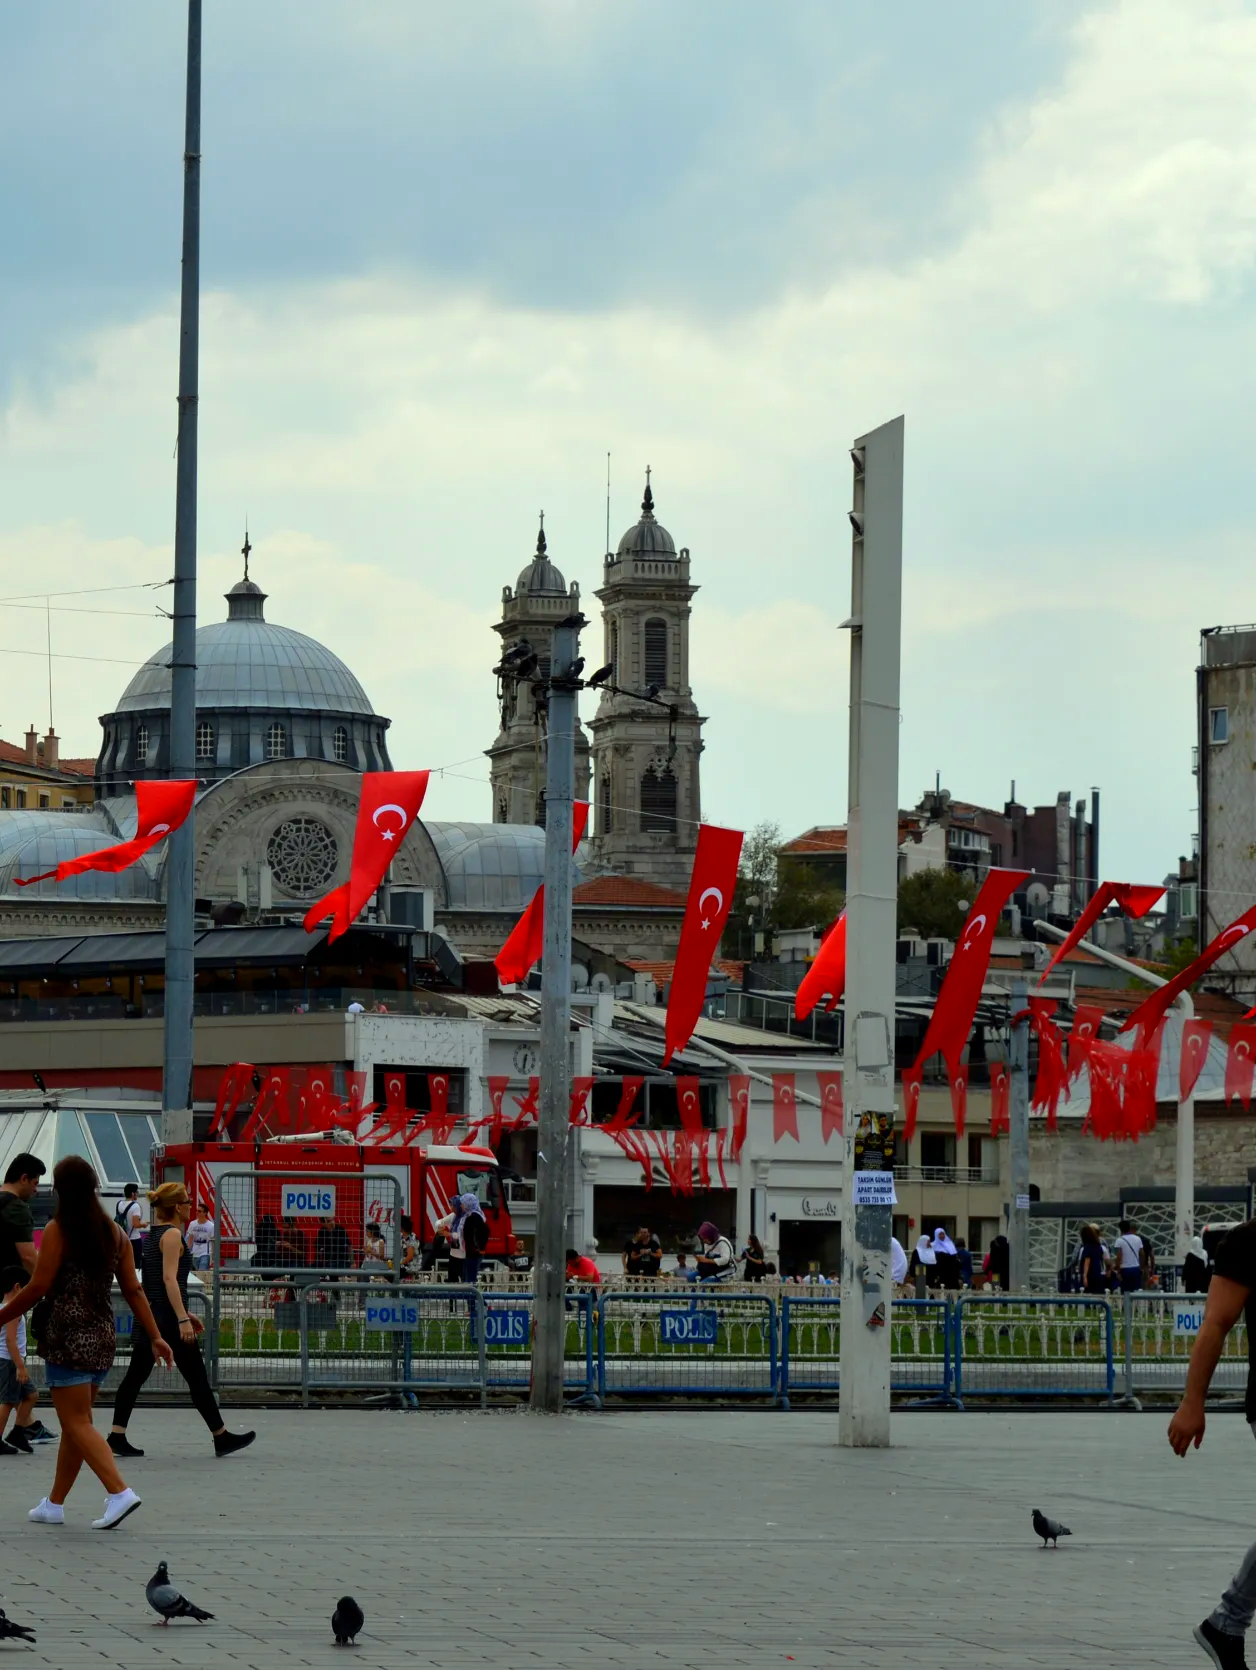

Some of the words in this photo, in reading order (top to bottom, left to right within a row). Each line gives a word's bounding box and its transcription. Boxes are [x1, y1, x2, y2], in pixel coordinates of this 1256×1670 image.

[286, 1189, 332, 1211] POLİS
[367, 1304, 417, 1324] POLİS
[1177, 1310, 1204, 1330] POLİ
